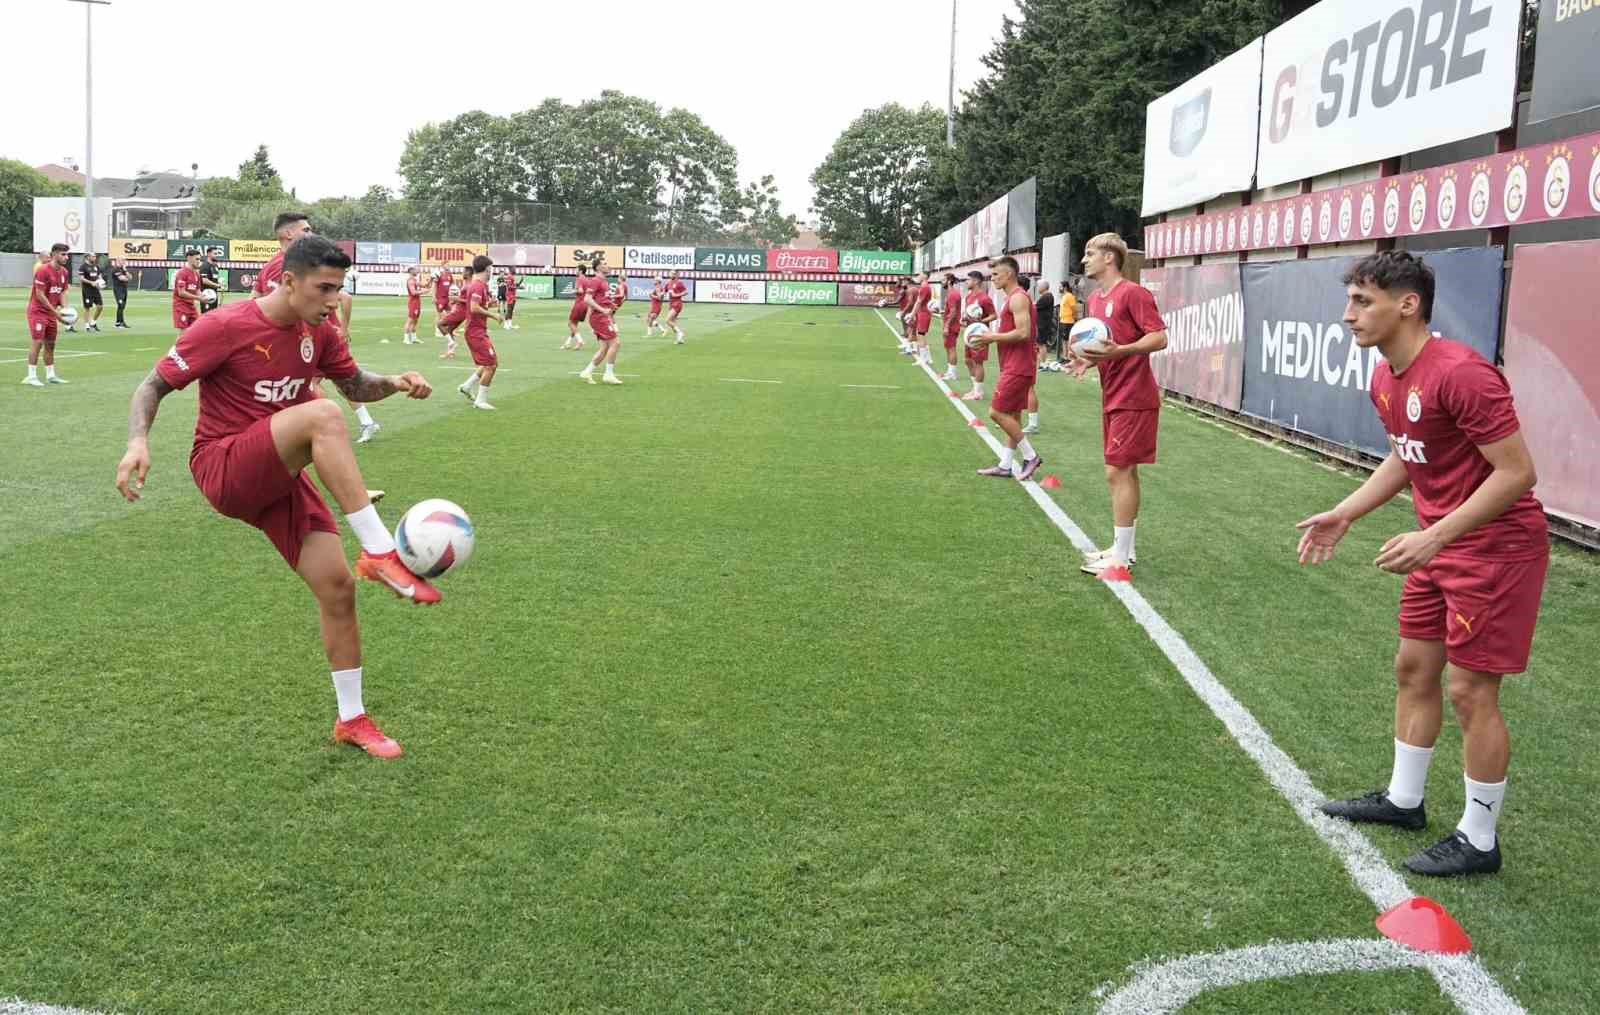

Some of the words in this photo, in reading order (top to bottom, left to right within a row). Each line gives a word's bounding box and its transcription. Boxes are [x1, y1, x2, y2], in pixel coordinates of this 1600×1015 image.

[1316, 0, 1493, 128] STORE
[427, 248, 464, 260] PUMA
[640, 253, 692, 267] tatilsepeti
[715, 254, 761, 267] RAMS
[841, 253, 908, 273] Bilyoner
[768, 283, 833, 302] Bilyoner
